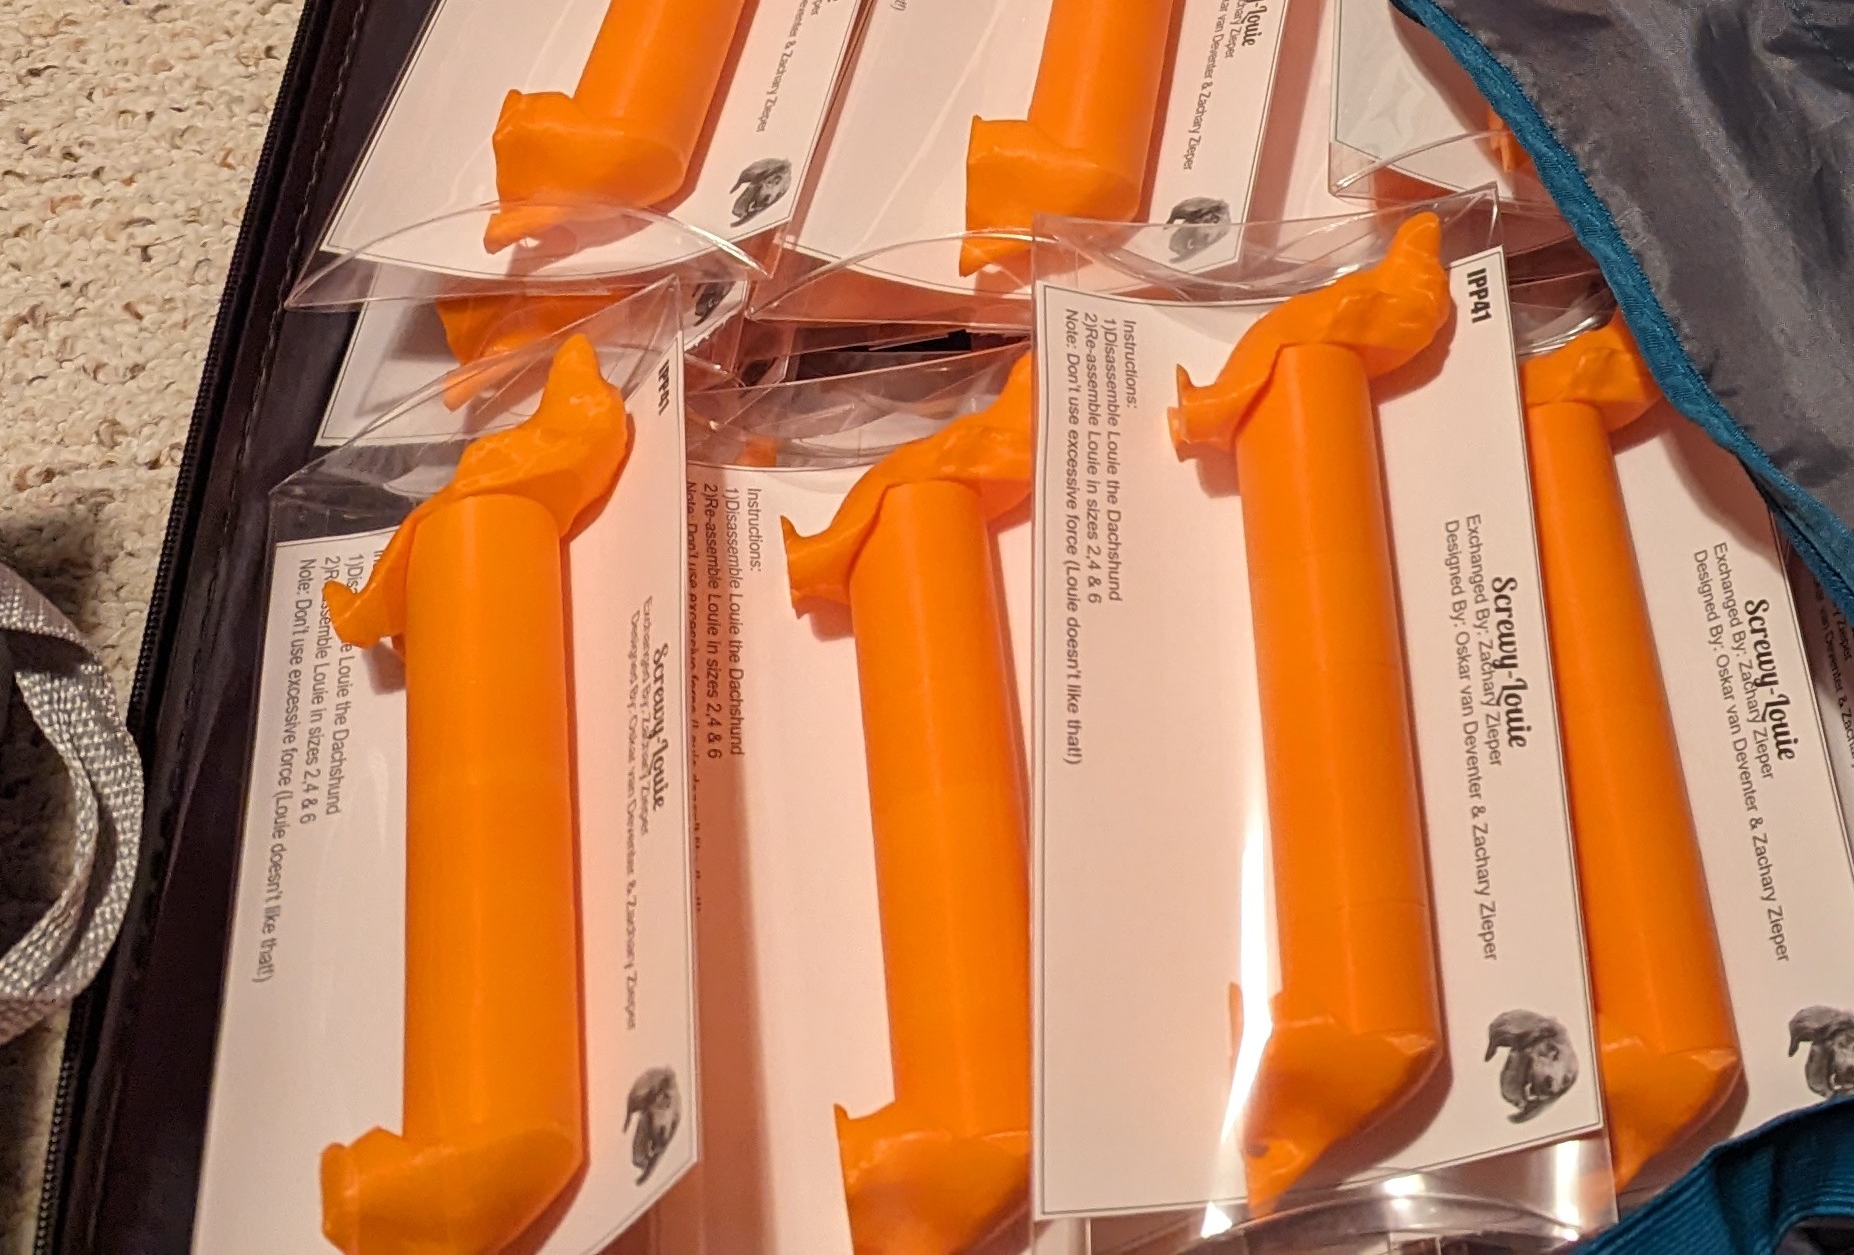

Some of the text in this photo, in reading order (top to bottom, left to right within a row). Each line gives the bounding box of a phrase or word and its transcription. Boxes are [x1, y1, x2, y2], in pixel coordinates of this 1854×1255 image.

[1466, 267, 1492, 324] IPP41
[1123, 319, 1138, 409] Instructions:
[1081, 312, 1103, 604] 2)Re-assemble Louie in sizes 2,4 & 6
[1099, 318, 1123, 602] 1)Disassemble Louie the Dachshund
[747, 488, 764, 572] Instructions:
[1062, 308, 1083, 765] Note: Don't use excessive force (Louie doesn't like that!)
[296, 558, 318, 595] Note:
[289, 638, 305, 666] use
[700, 483, 723, 759] 2)Re-assemble Louie in sizes 2,4 & 6
[721, 487, 746, 756] 1)Disassemble Louie the Dachshund
[1466, 513, 1502, 766] Exchanged By: Zachary Zieper
[1490, 576, 1531, 748] Screwy-Louie
[1713, 541, 1774, 779] Exchanged By: Zachary Zieper
[282, 668, 302, 745] excessive
[310, 662, 331, 705] Louie
[310, 707, 328, 724] in
[1744, 597, 1799, 761] Screwy-Louie
[277, 746, 299, 787] force
[305, 726, 325, 766] sizes
[325, 655, 356, 816] Louie the Dachshund
[1444, 519, 1497, 961] Designed By: Oskar van Deventer & Zachary Zieper
[1693, 549, 1789, 961] Designed By: Oskar van Deventer & Zachary Zieper
[271, 789, 294, 840] (Louie
[299, 812, 317, 825] 6
[300, 797, 319, 811] &
[301, 768, 322, 794] 2,4
[261, 905, 281, 935] like
